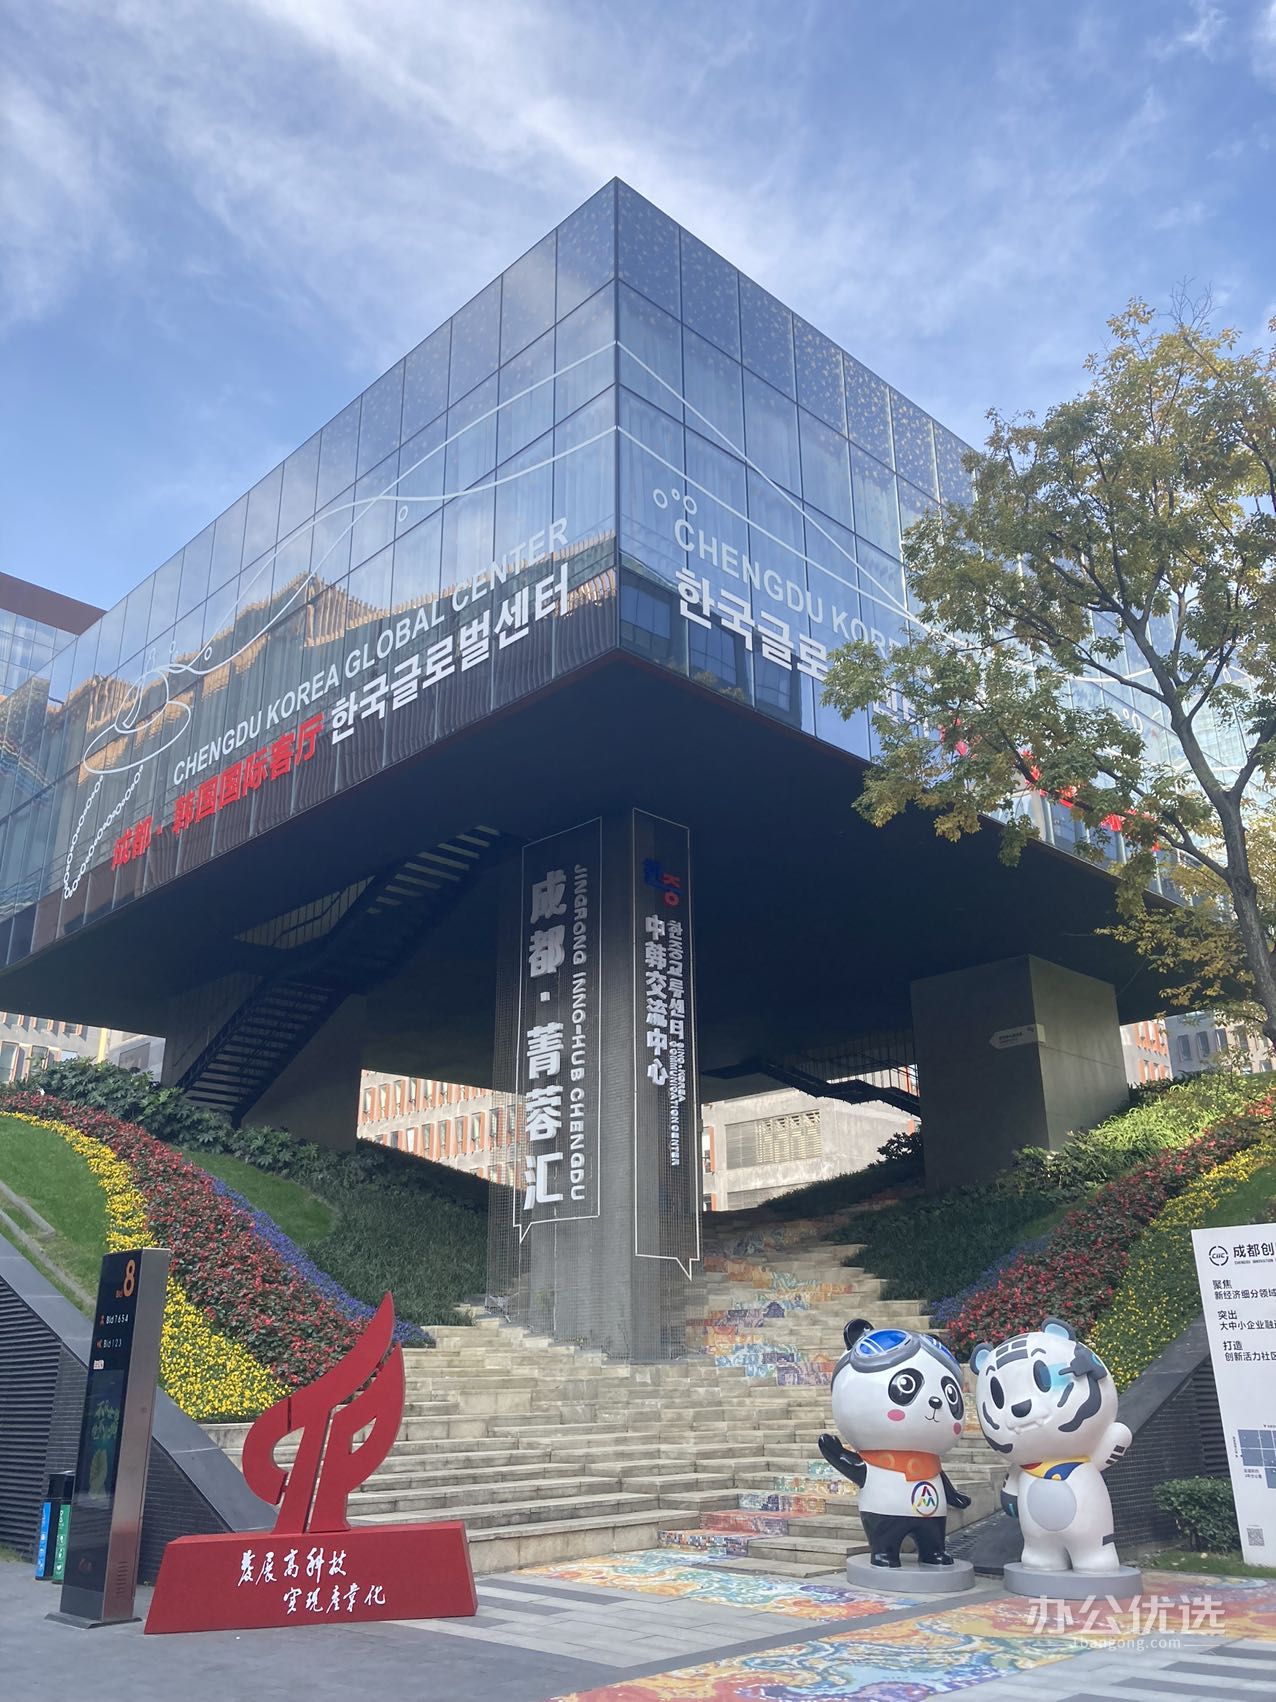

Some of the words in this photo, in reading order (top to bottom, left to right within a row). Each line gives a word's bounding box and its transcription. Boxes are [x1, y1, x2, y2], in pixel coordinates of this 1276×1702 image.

[674, 518, 823, 624] CHENGDU
[173, 710, 262, 786] CHENGDU
[266, 663, 340, 730] KOREA
[345, 604, 445, 679] GLOBAL
[451, 517, 569, 612] CENTER
[331, 562, 569, 745] 한국글로벌센터
[572, 864, 588, 966] JINGRONG
[570, 971, 587, 1082] INNO-HUB
[569, 1087, 586, 1201] CHENGDU
[123, 1259, 136, 1297] 8
[1212, 1279, 1233, 1290] 聚焦
[1233, 1242, 1276, 1258] 成都创
[1218, 1309, 1237, 1321] 突出
[1219, 1319, 1276, 1331] 大中小企业融
[1223, 1340, 1243, 1351] 打造
